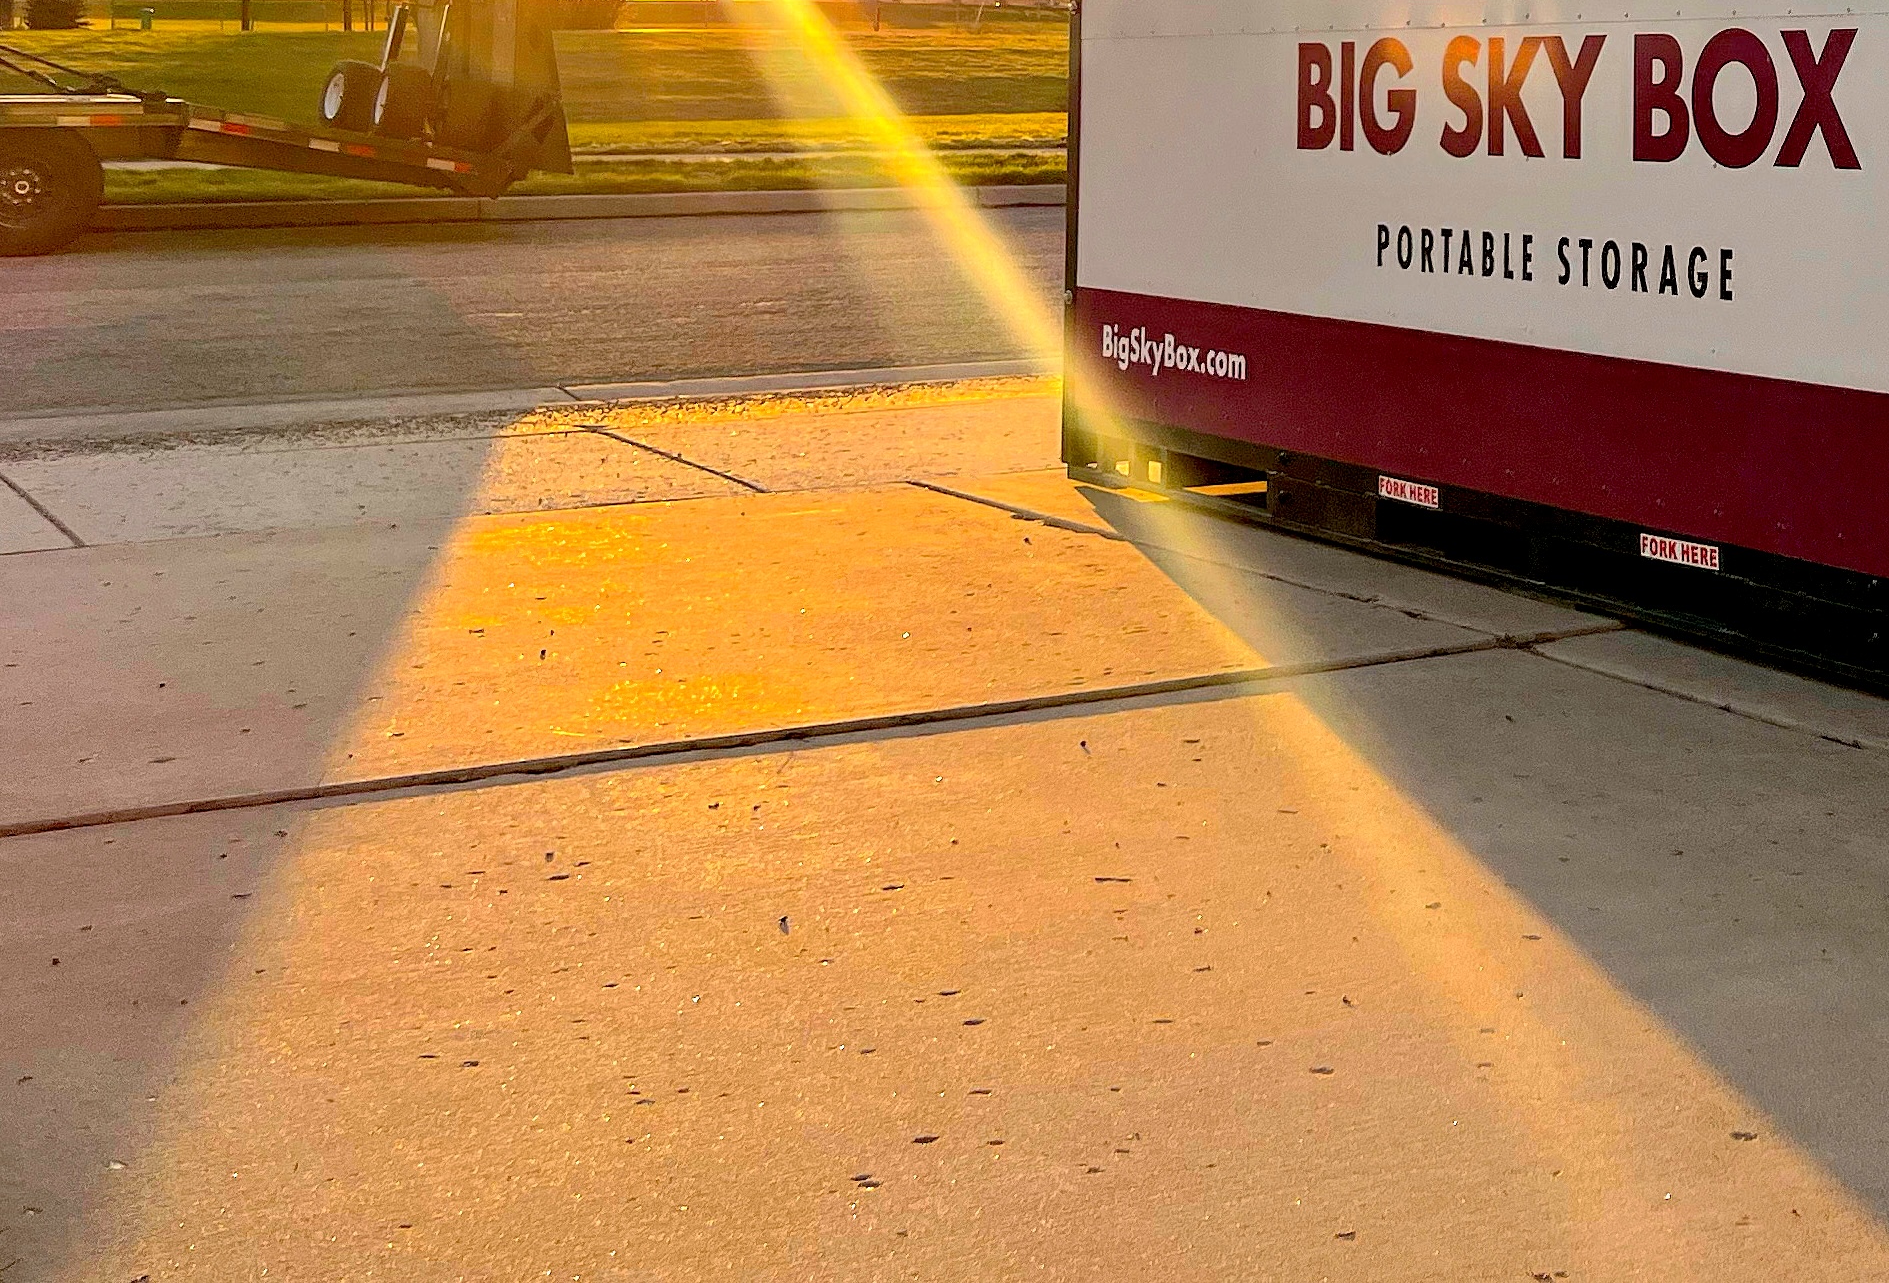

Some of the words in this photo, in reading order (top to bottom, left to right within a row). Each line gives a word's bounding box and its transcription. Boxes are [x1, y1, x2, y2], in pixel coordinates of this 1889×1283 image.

[1296, 37, 1417, 157] BIG
[1439, 34, 1608, 161] SKY
[1633, 28, 1862, 171] BOX
[1376, 224, 1534, 282] PORTABLE
[1557, 235, 1736, 302] STORAGE
[1102, 323, 1246, 380] BigSkyBox.com
[1380, 477, 1407, 498] FORK
[1409, 485, 1438, 506] HERE
[1641, 535, 1678, 560] FORK
[1681, 543, 1718, 568] HERE
